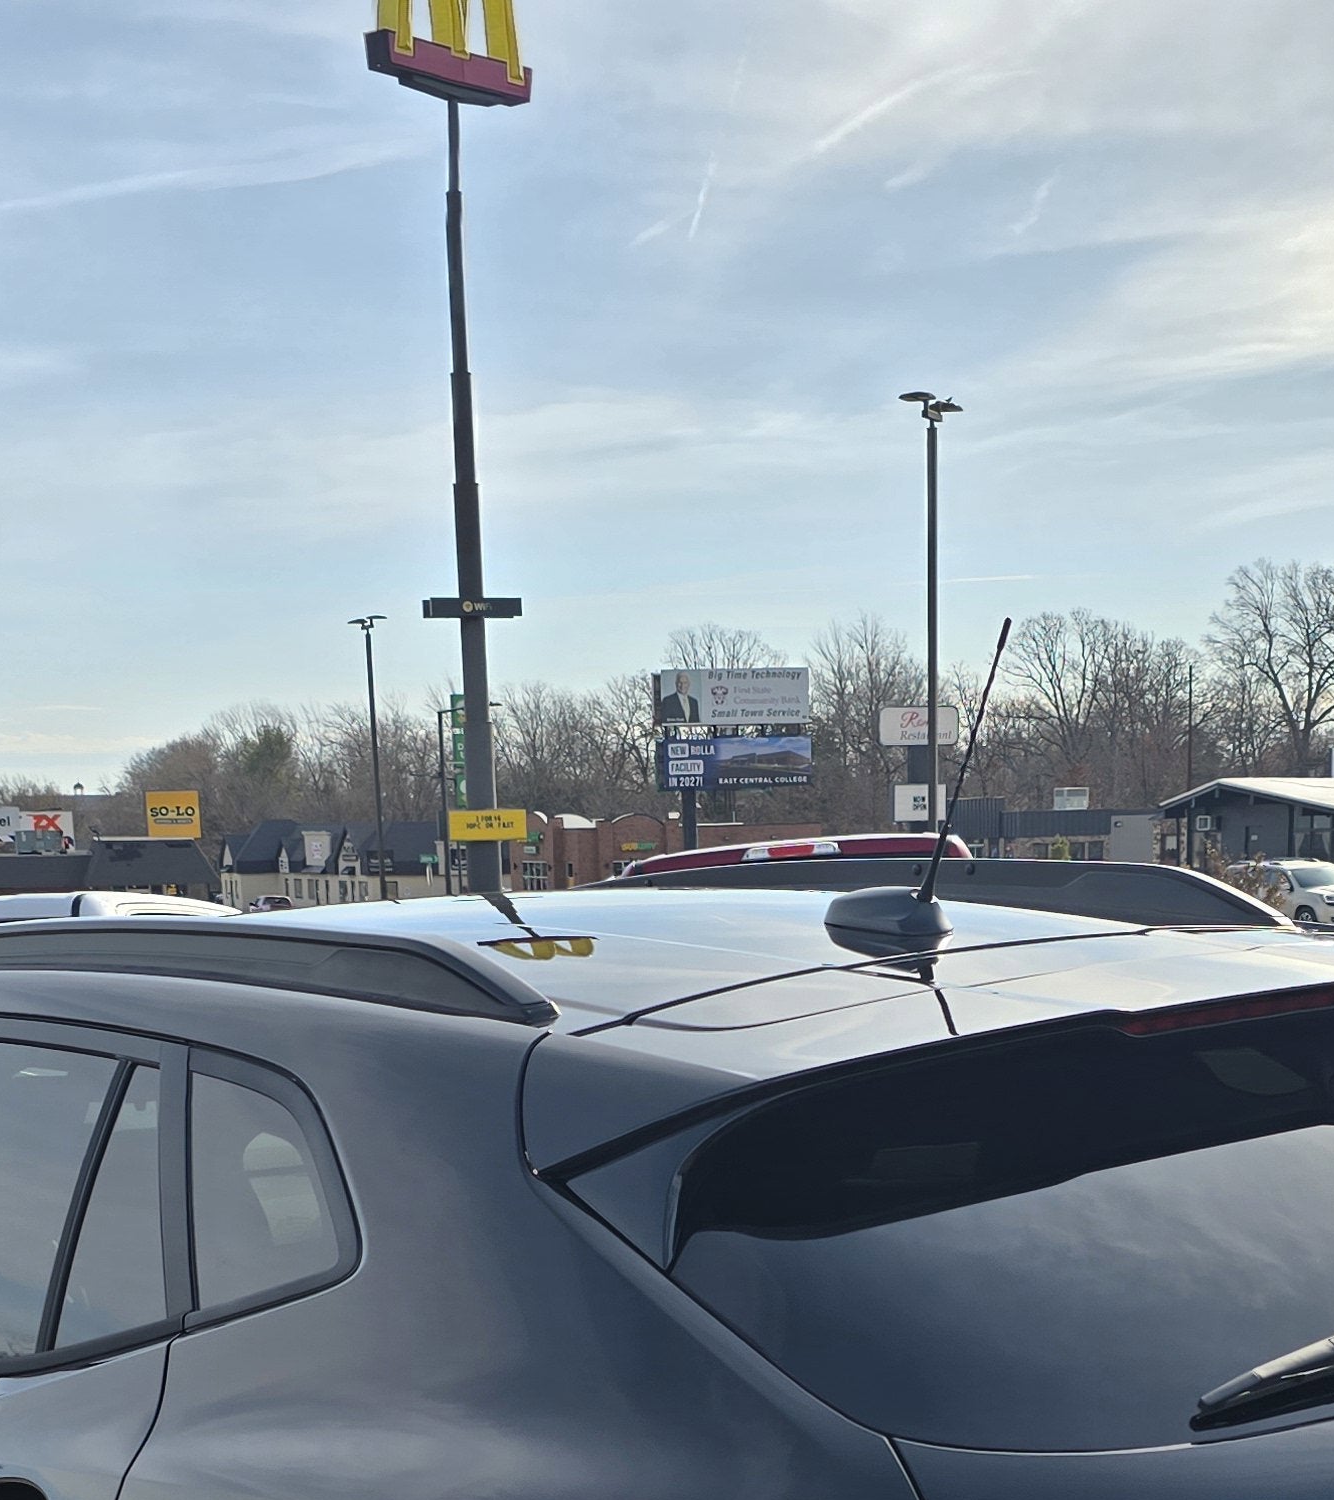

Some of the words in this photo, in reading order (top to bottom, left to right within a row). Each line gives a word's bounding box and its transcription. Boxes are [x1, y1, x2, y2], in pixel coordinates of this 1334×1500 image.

[708, 670, 722, 681] Big
[726, 670, 748, 680] Time
[751, 670, 802, 681] Technology
[711, 708, 737, 718] Small
[740, 708, 764, 718] Town
[767, 707, 800, 717] Service
[670, 744, 688, 756] NEW
[671, 761, 702, 773] FACILITY
[669, 777, 678, 787] IN
[718, 777, 737, 785] EAST
[739, 776, 773, 784] CENTRAL
[774, 775, 808, 783] COLLEGE
[150, 806, 195, 817] SO-LO
